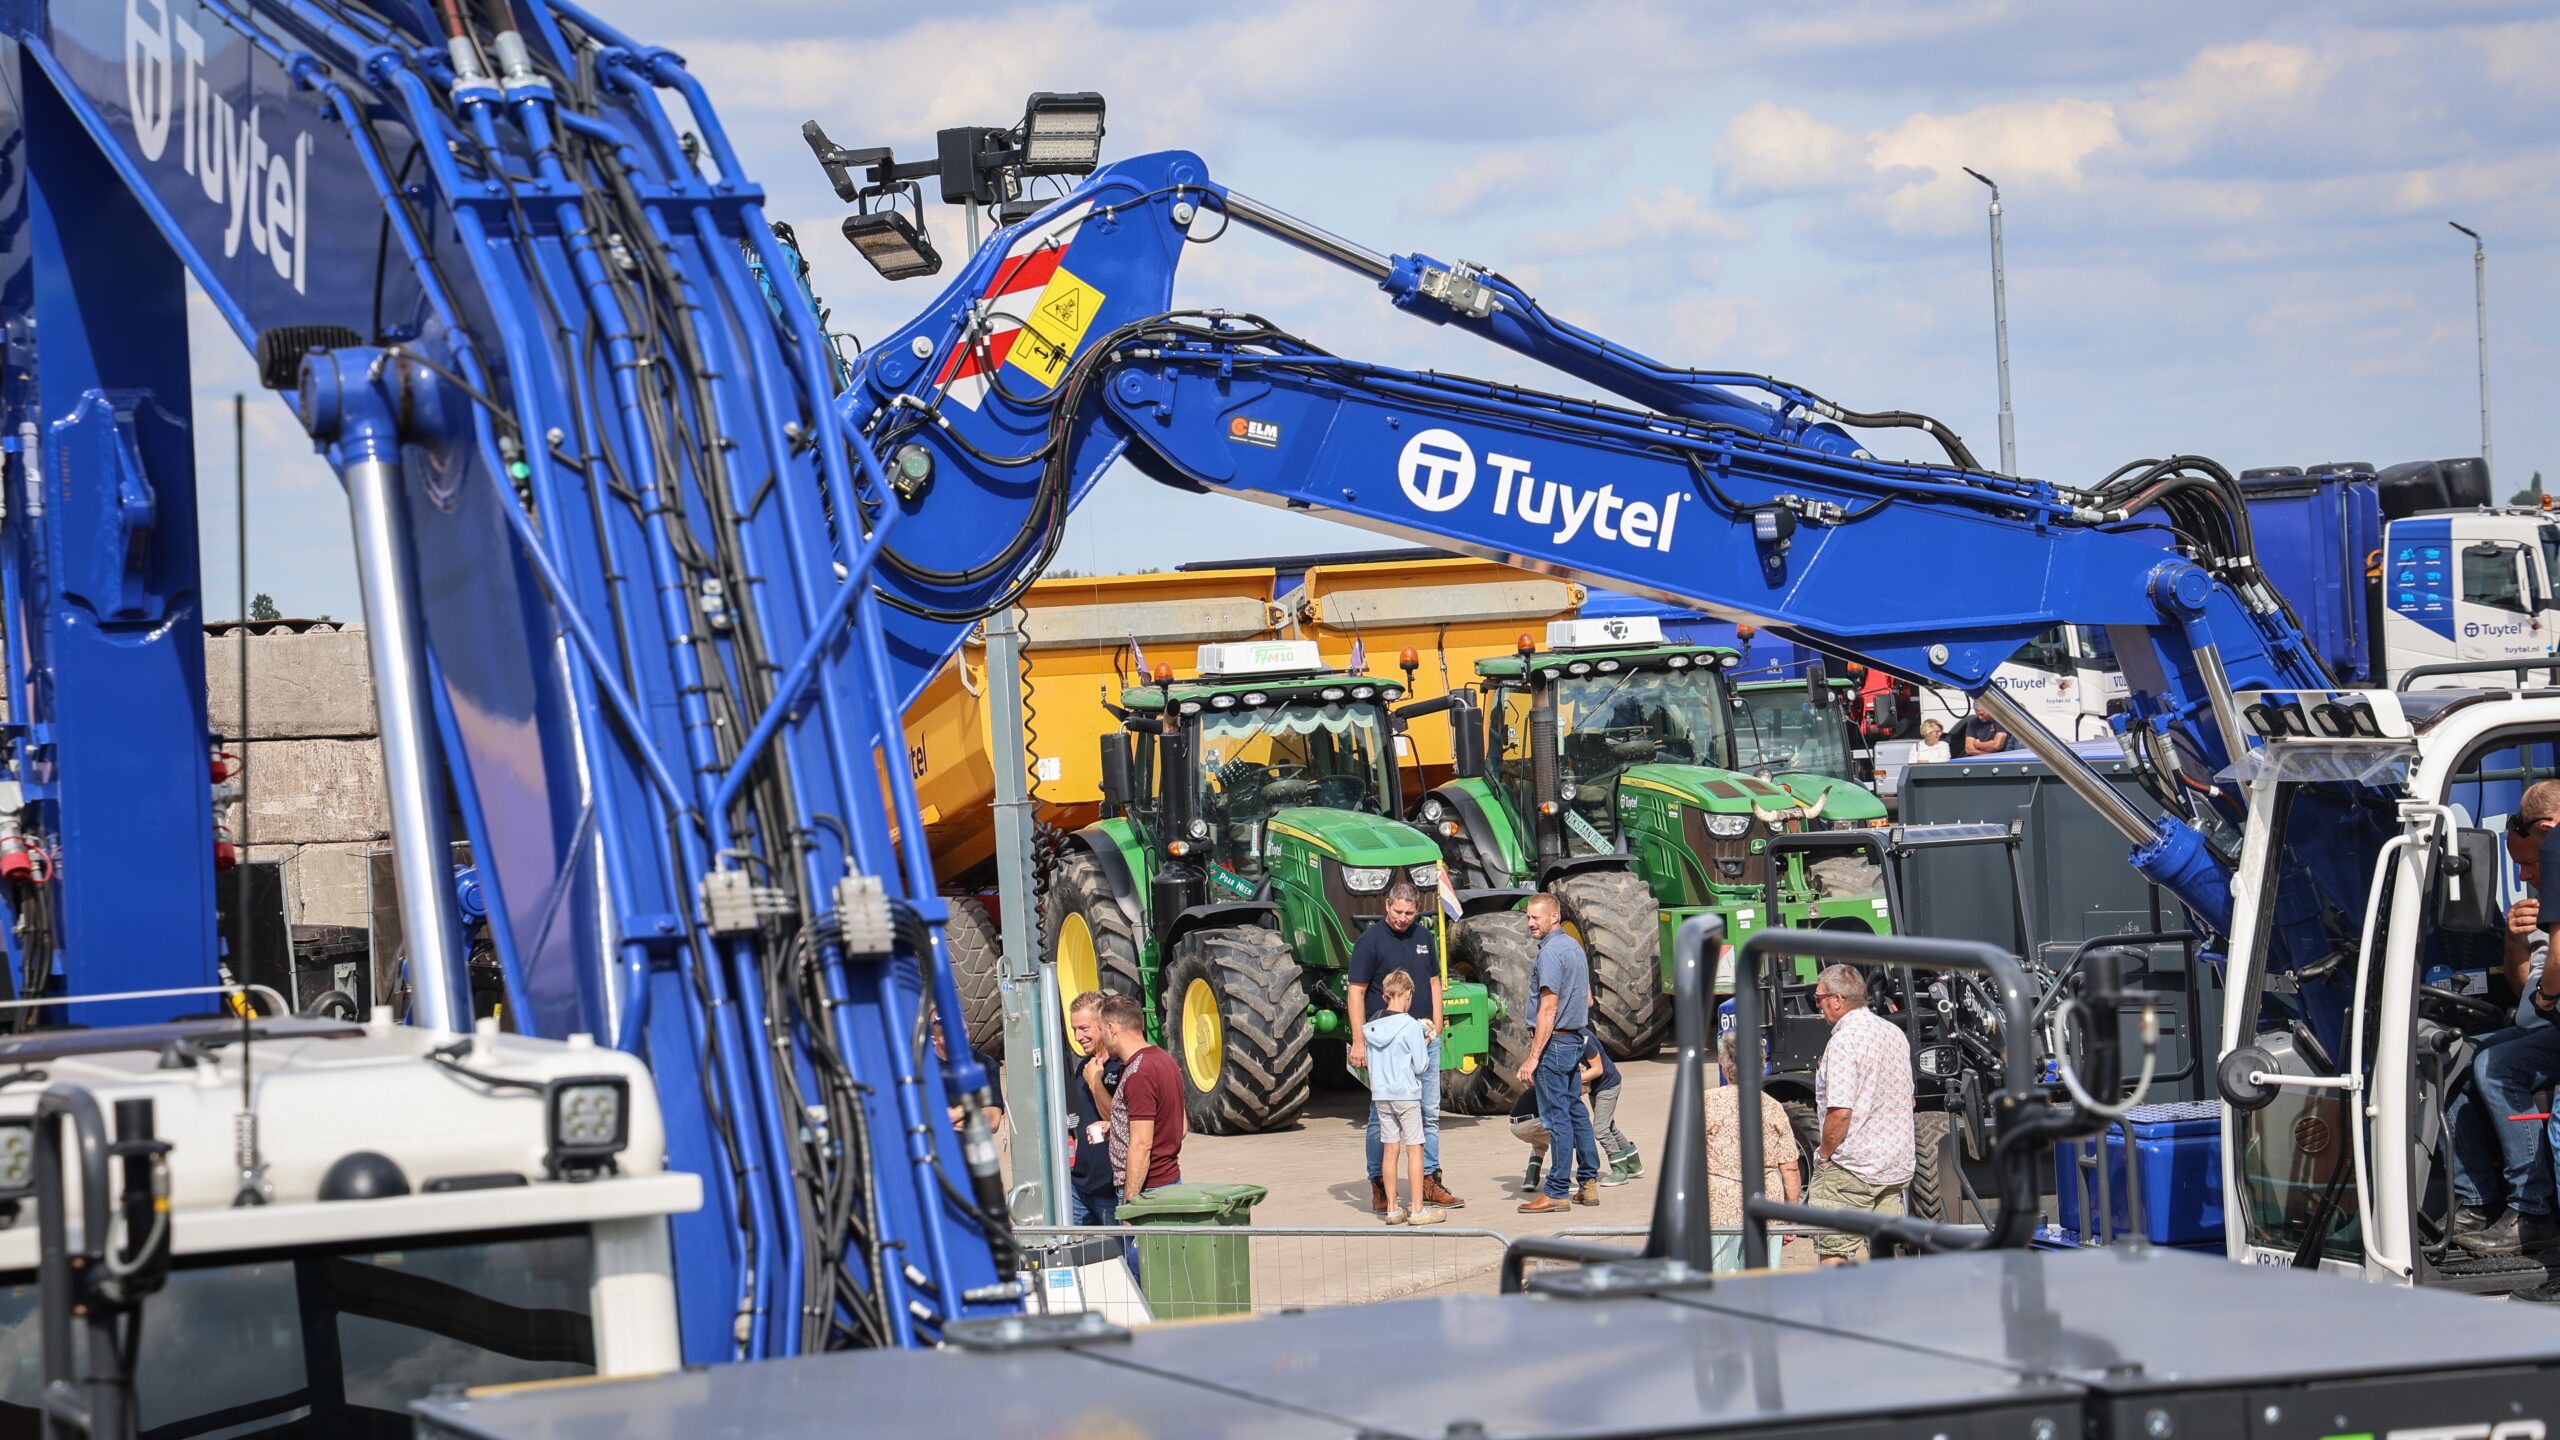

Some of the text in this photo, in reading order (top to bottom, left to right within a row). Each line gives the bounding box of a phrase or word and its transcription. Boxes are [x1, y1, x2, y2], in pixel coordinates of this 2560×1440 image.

[175, 14, 314, 296] Tuytel
[1486, 452, 1681, 552] Tuytel
[2481, 623, 2522, 637] Tuytel
[2505, 645, 2540, 654] tuytel.nl
[2010, 678, 2046, 690] Tuytel
[910, 730, 928, 779] tel
[1625, 796, 1638, 810] Tuytel
